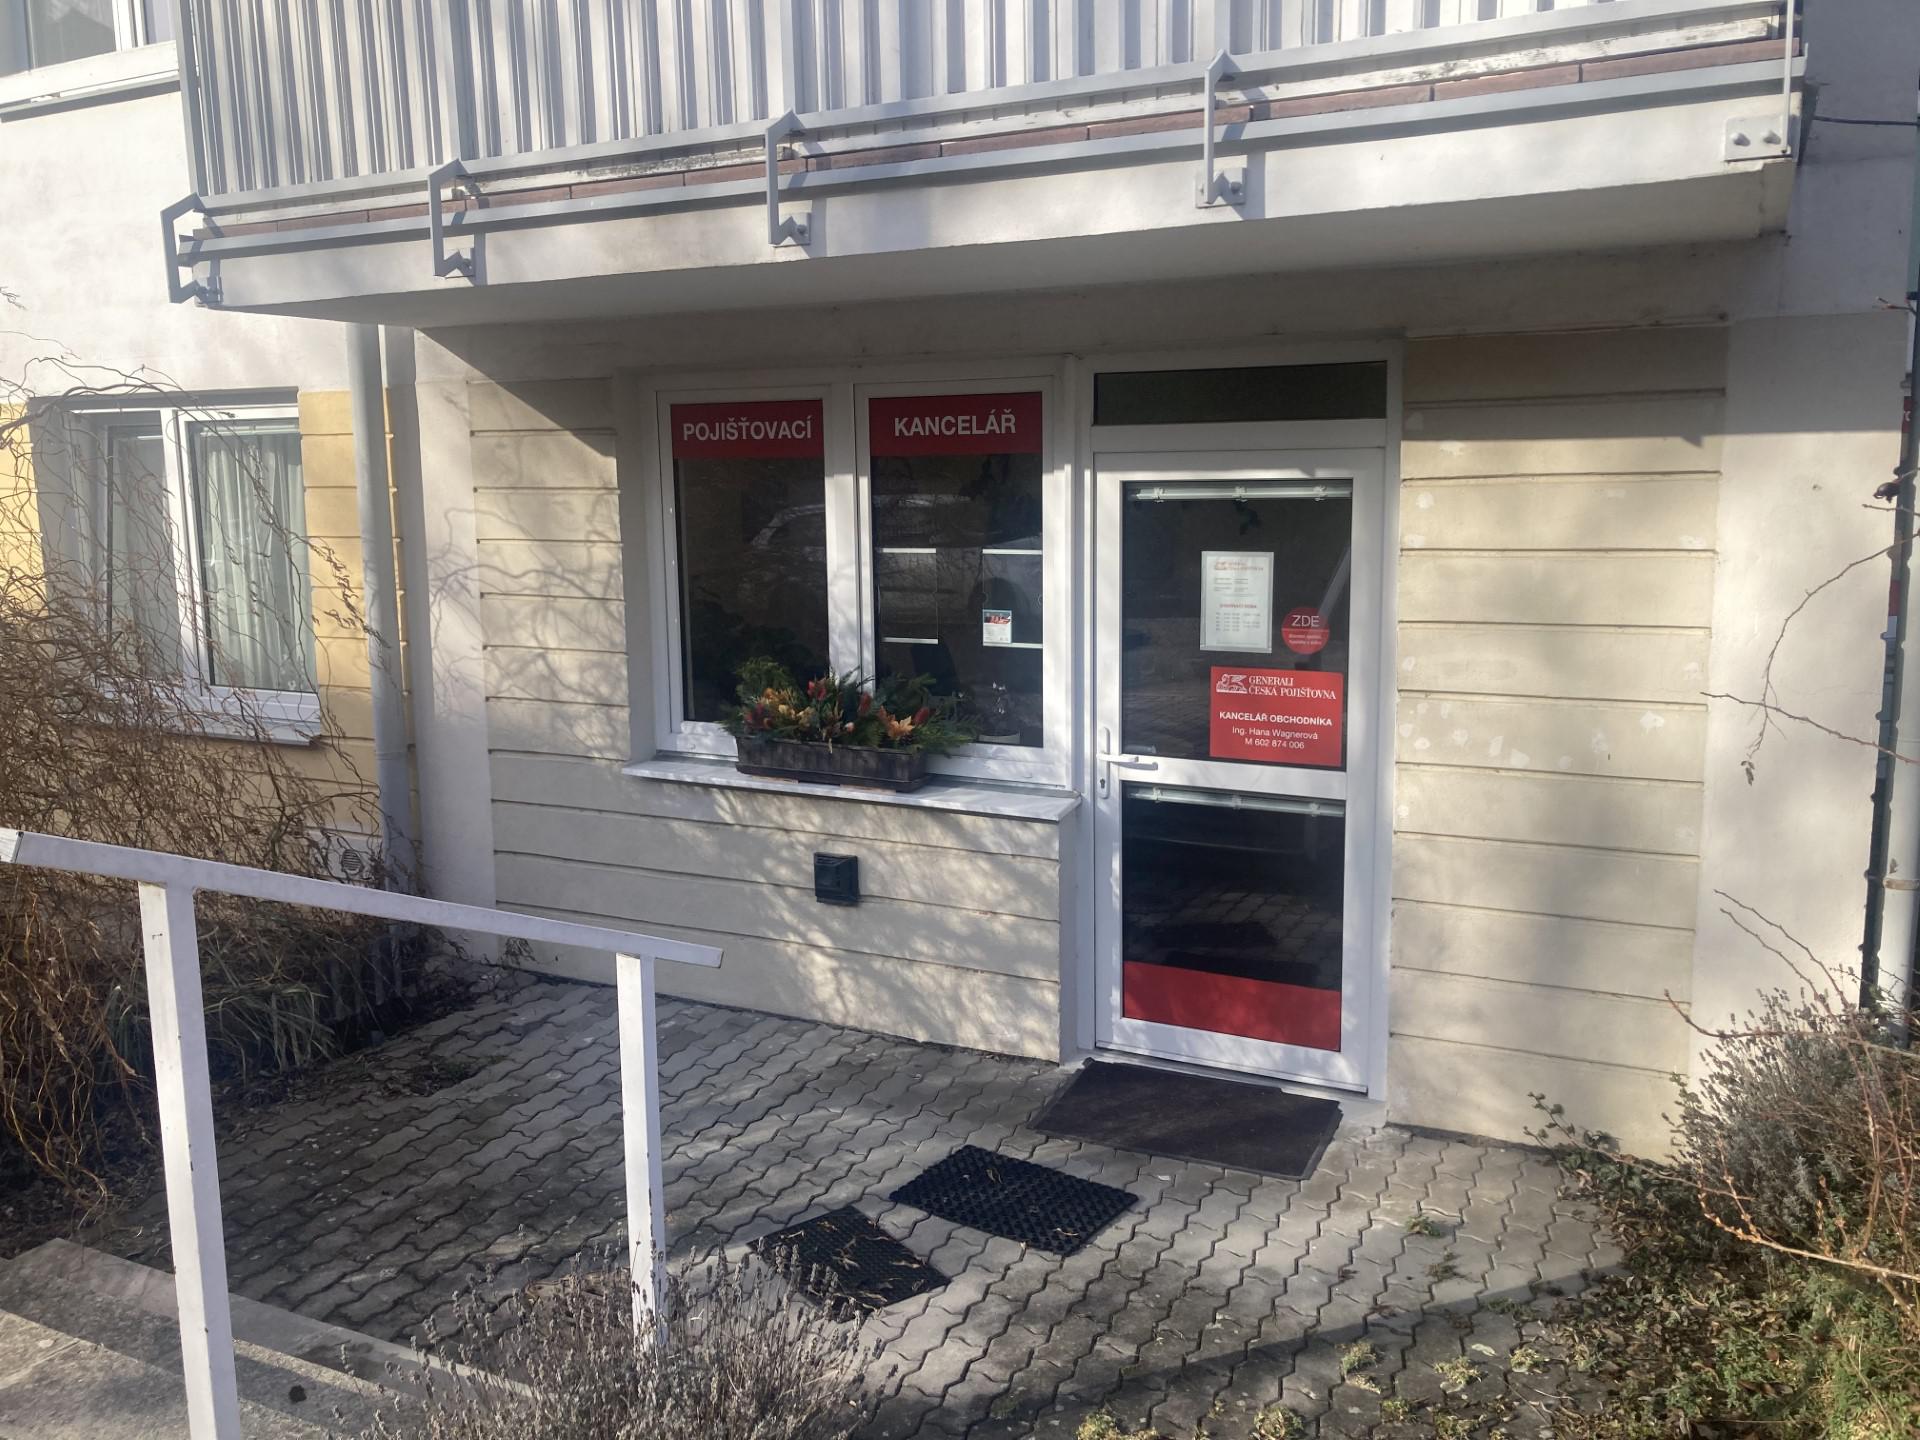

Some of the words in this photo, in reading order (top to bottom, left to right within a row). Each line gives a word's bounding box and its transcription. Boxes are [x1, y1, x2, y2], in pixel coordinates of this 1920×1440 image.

[683, 415, 812, 441] POJIŠŤOVACÍ
[894, 409, 1017, 437] KANCELÁŘ
[1291, 615, 1320, 626] ZDE
[1248, 675, 1294, 686] GENERALI
[1248, 684, 1277, 696] ČESKÁ
[1280, 686, 1337, 700] POJIŠŤOVNA
[1219, 711, 1268, 722] KANCELÁŘ
[1269, 714, 1332, 726] OBCHODNÍKA
[1232, 726, 1246, 736] Ing.
[1249, 727, 1270, 736] Hana
[1272, 728, 1318, 740] Wagnerová
[1254, 738, 1269, 746] 602
